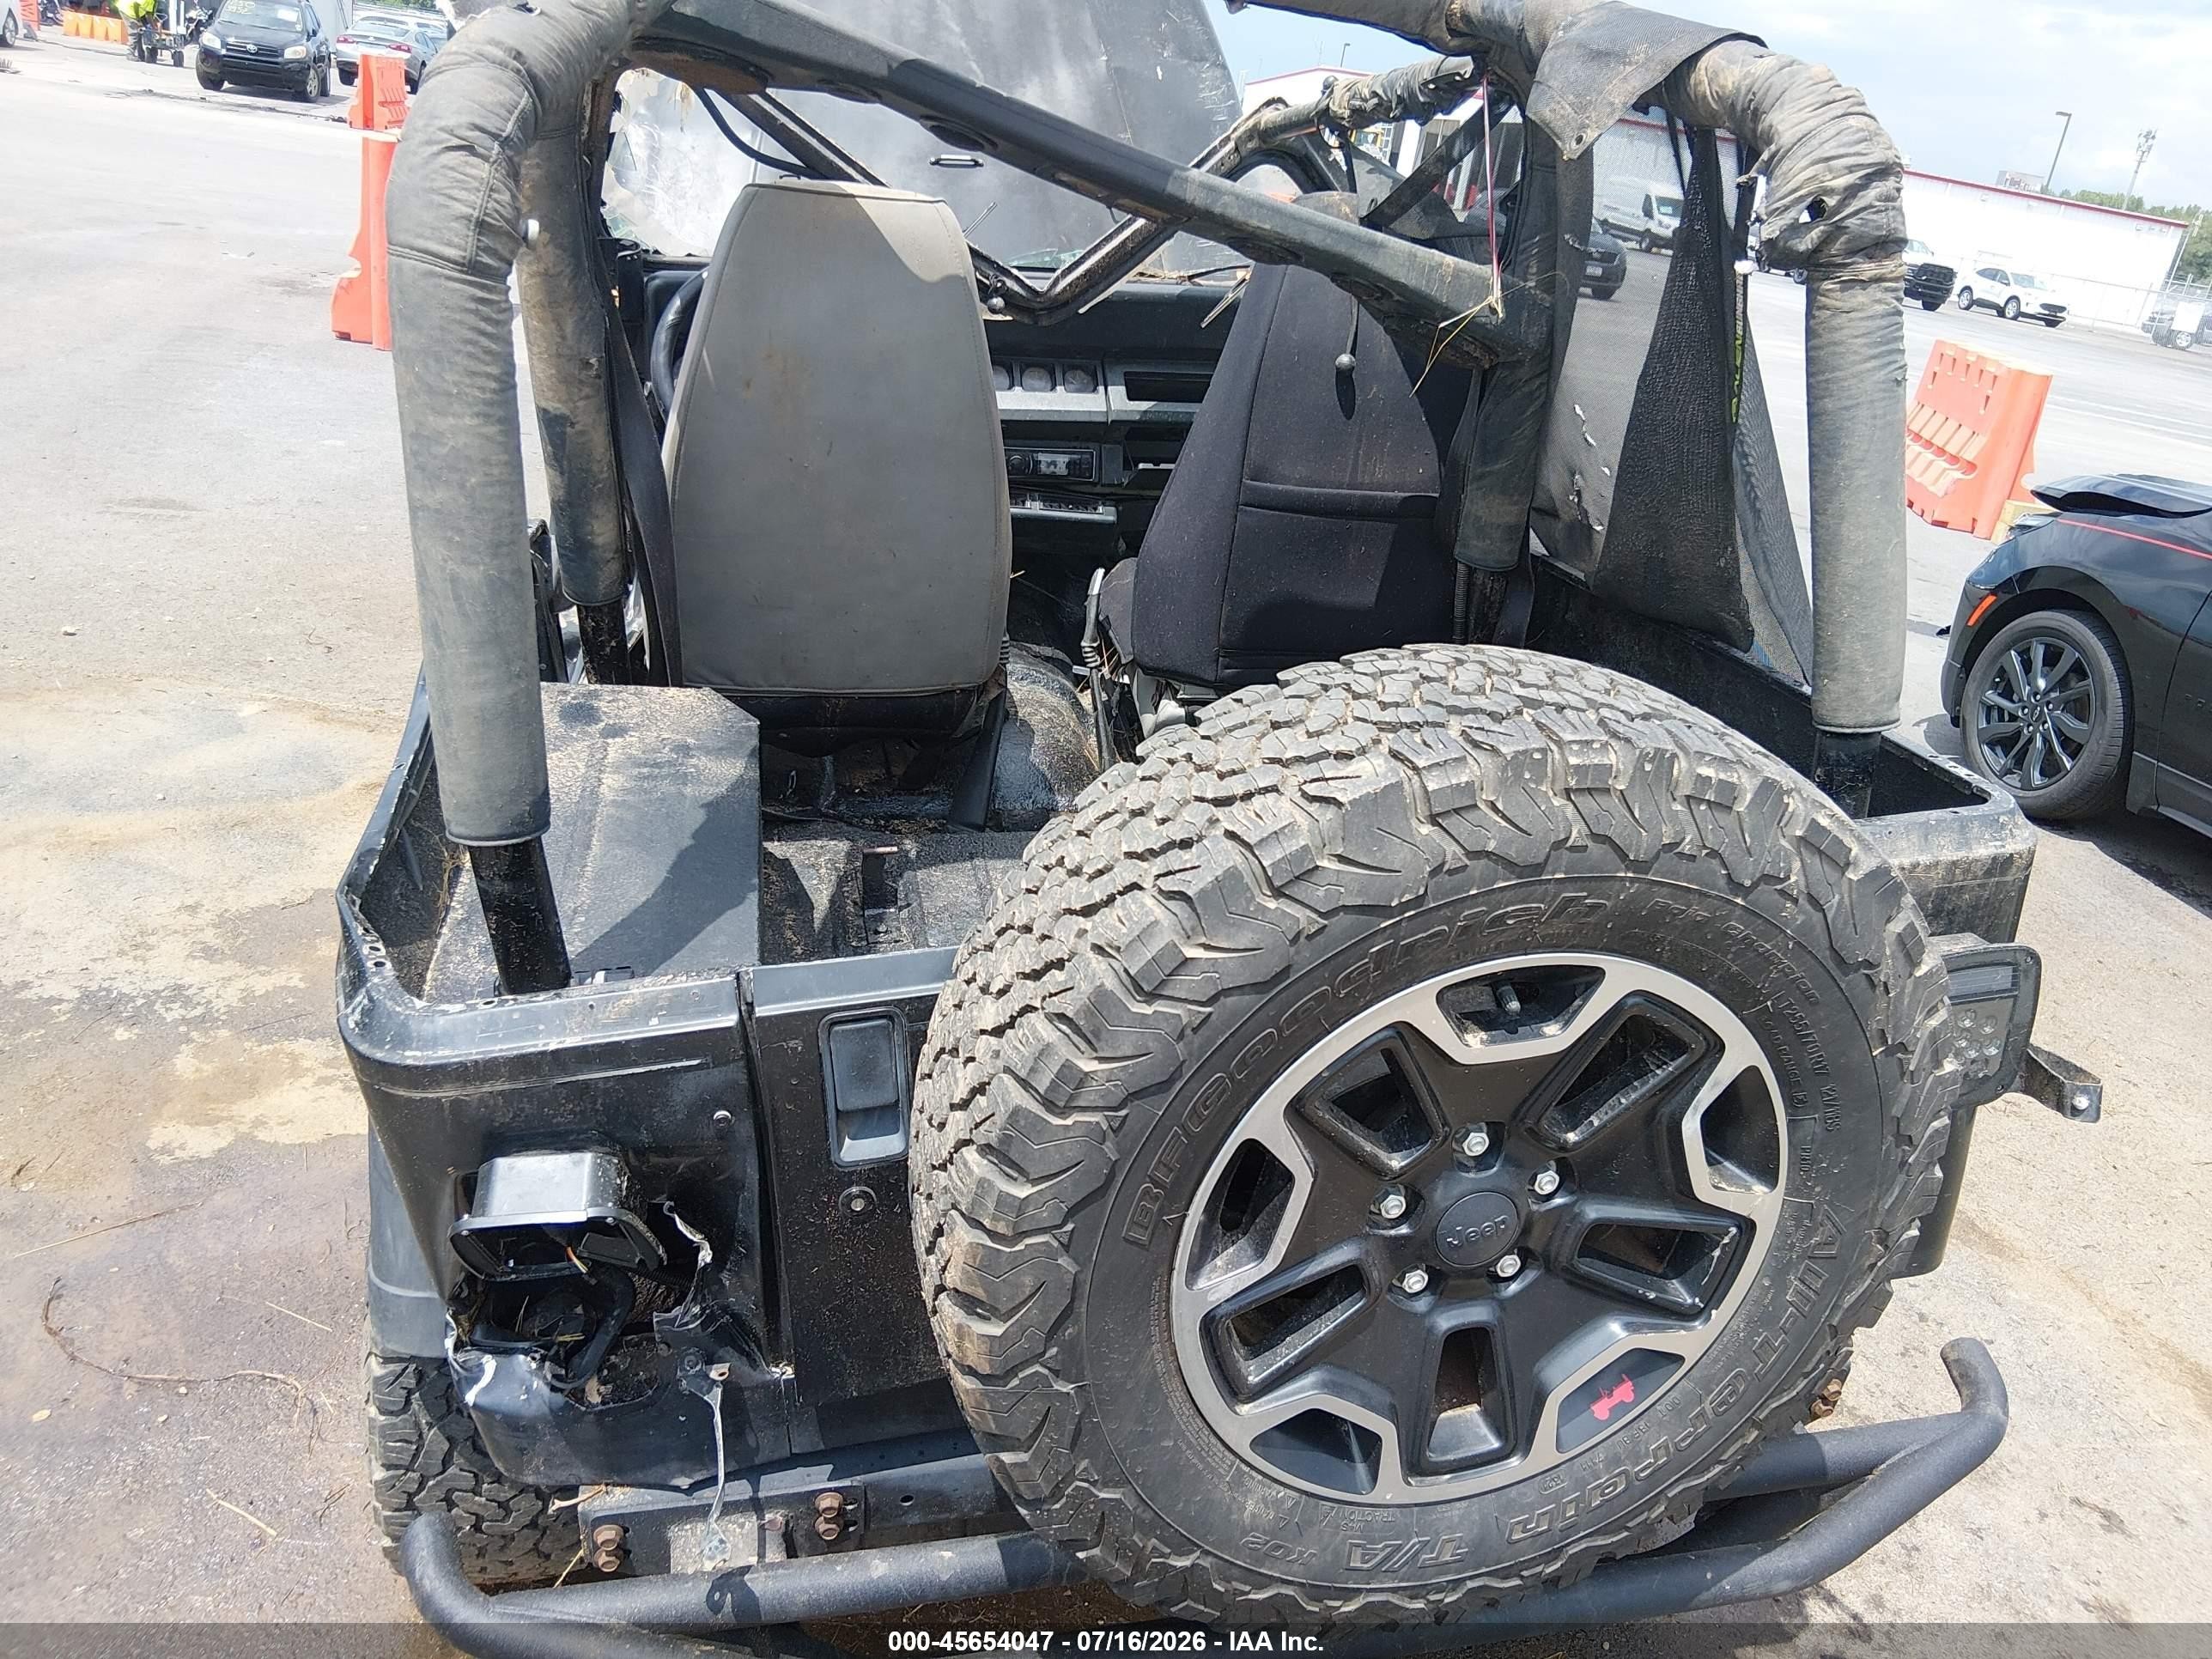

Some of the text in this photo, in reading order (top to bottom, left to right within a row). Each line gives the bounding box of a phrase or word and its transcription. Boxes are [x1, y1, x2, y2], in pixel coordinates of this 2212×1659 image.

[1720, 921, 1820, 1005] Champion
[1121, 893, 1609, 1246] BFGoodrich
[1770, 990, 1830, 1076] LT255/70R17
[1446, 1213, 1510, 1246] Jeep
[1506, 1206, 1846, 1544] All-Terrain
[1240, 1531, 1316, 1567] KO2
[1344, 1533, 1468, 1571] T/A
